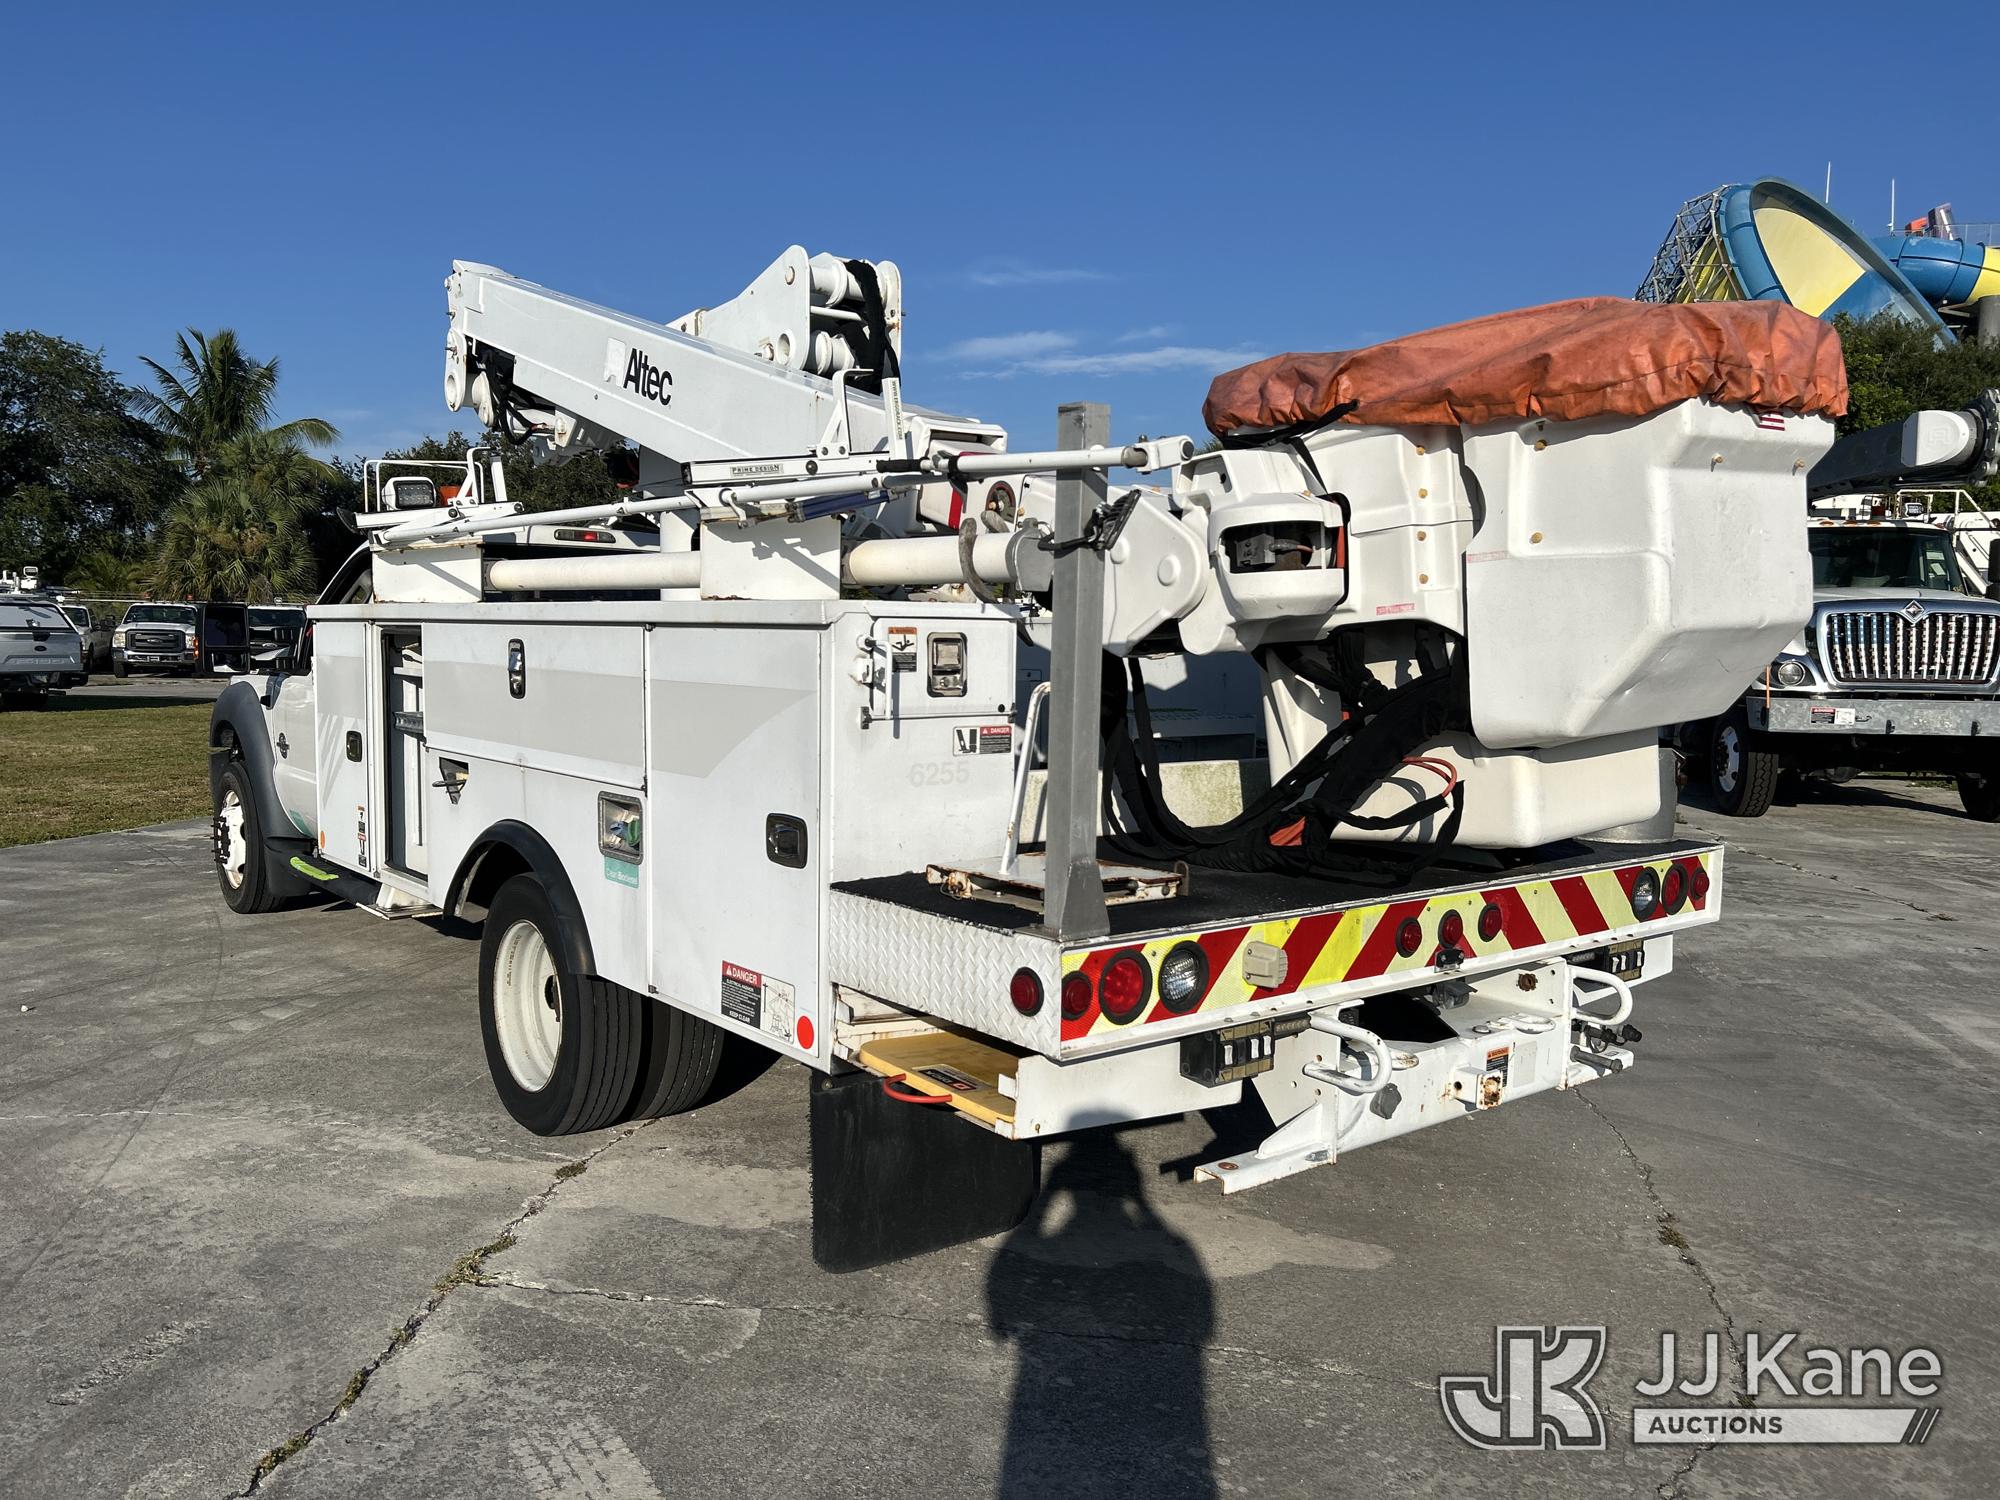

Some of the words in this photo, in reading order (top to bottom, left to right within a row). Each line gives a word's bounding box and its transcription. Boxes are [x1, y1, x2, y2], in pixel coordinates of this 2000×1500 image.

[623, 347, 673, 405] Altec
[909, 760, 970, 788] 6255
[732, 967, 758, 985] DANGER
